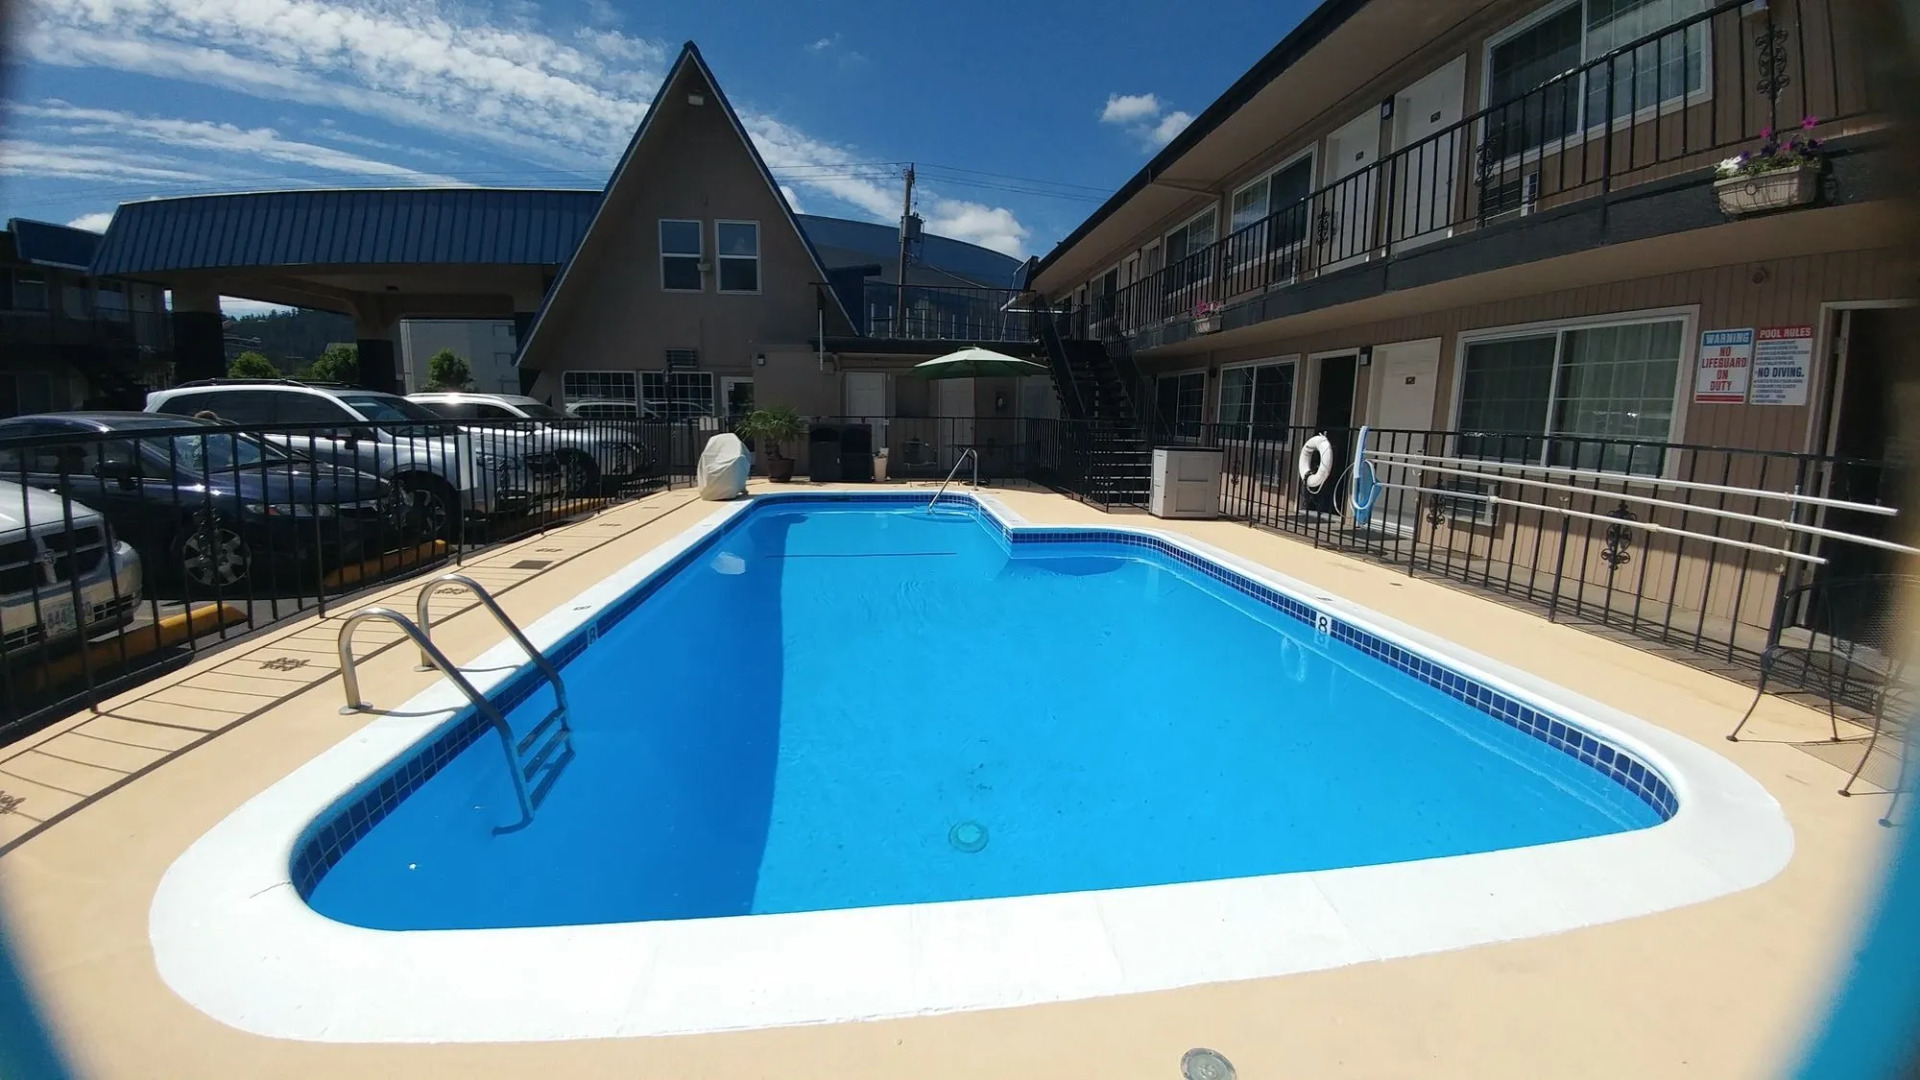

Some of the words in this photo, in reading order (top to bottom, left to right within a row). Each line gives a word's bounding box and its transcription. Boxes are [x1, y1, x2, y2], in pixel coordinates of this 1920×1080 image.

[1760, 328, 1781, 338] POOL
[1784, 327, 1811, 337] RULES
[1706, 332, 1749, 344] WARNING
[1719, 346, 1731, 356] NO
[1702, 357, 1747, 368] LIFEGUARD
[1716, 369, 1728, 379] ON
[1757, 367, 1769, 377] NO
[1710, 381, 1732, 391] DUTY
[1318, 616, 1328, 634] 8
